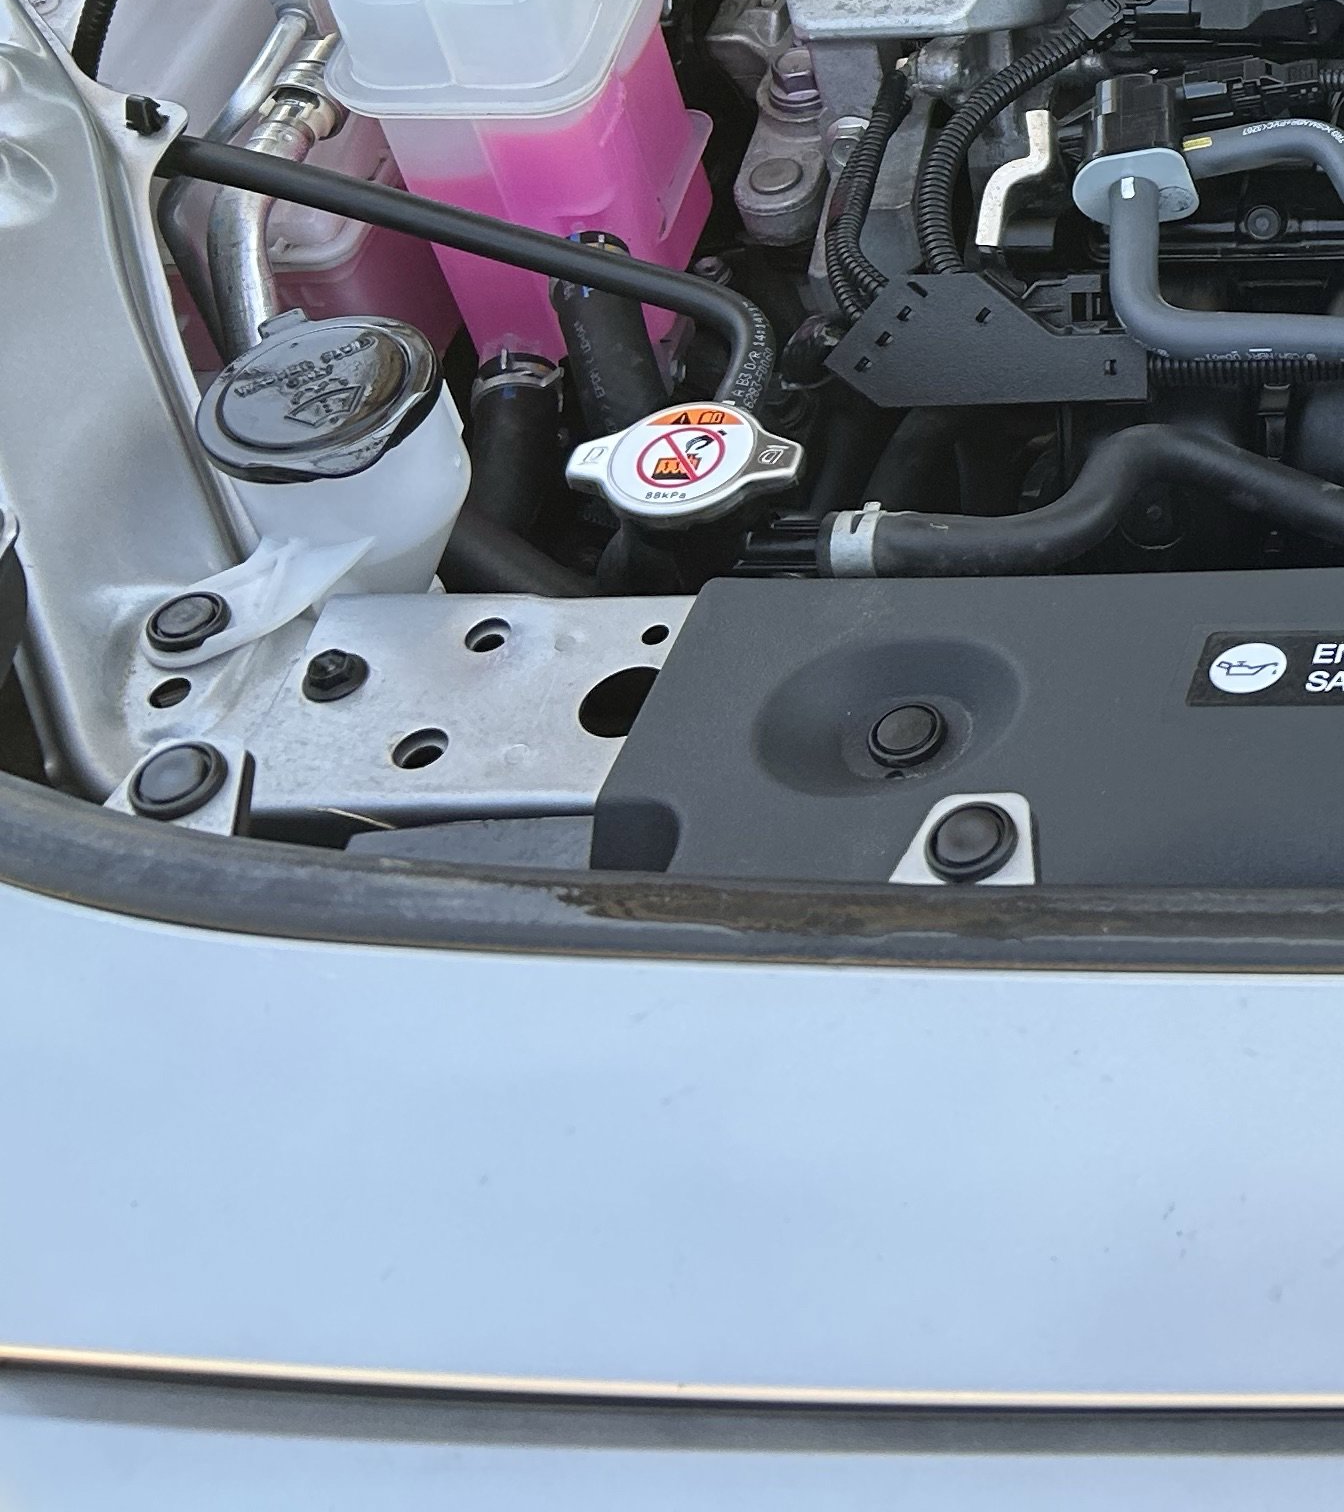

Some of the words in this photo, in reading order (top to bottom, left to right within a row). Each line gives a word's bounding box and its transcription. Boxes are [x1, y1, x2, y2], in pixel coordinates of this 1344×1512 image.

[233, 361, 315, 397] WASHER
[320, 336, 379, 363] FLUID
[644, 491, 687, 500] 88kPa
